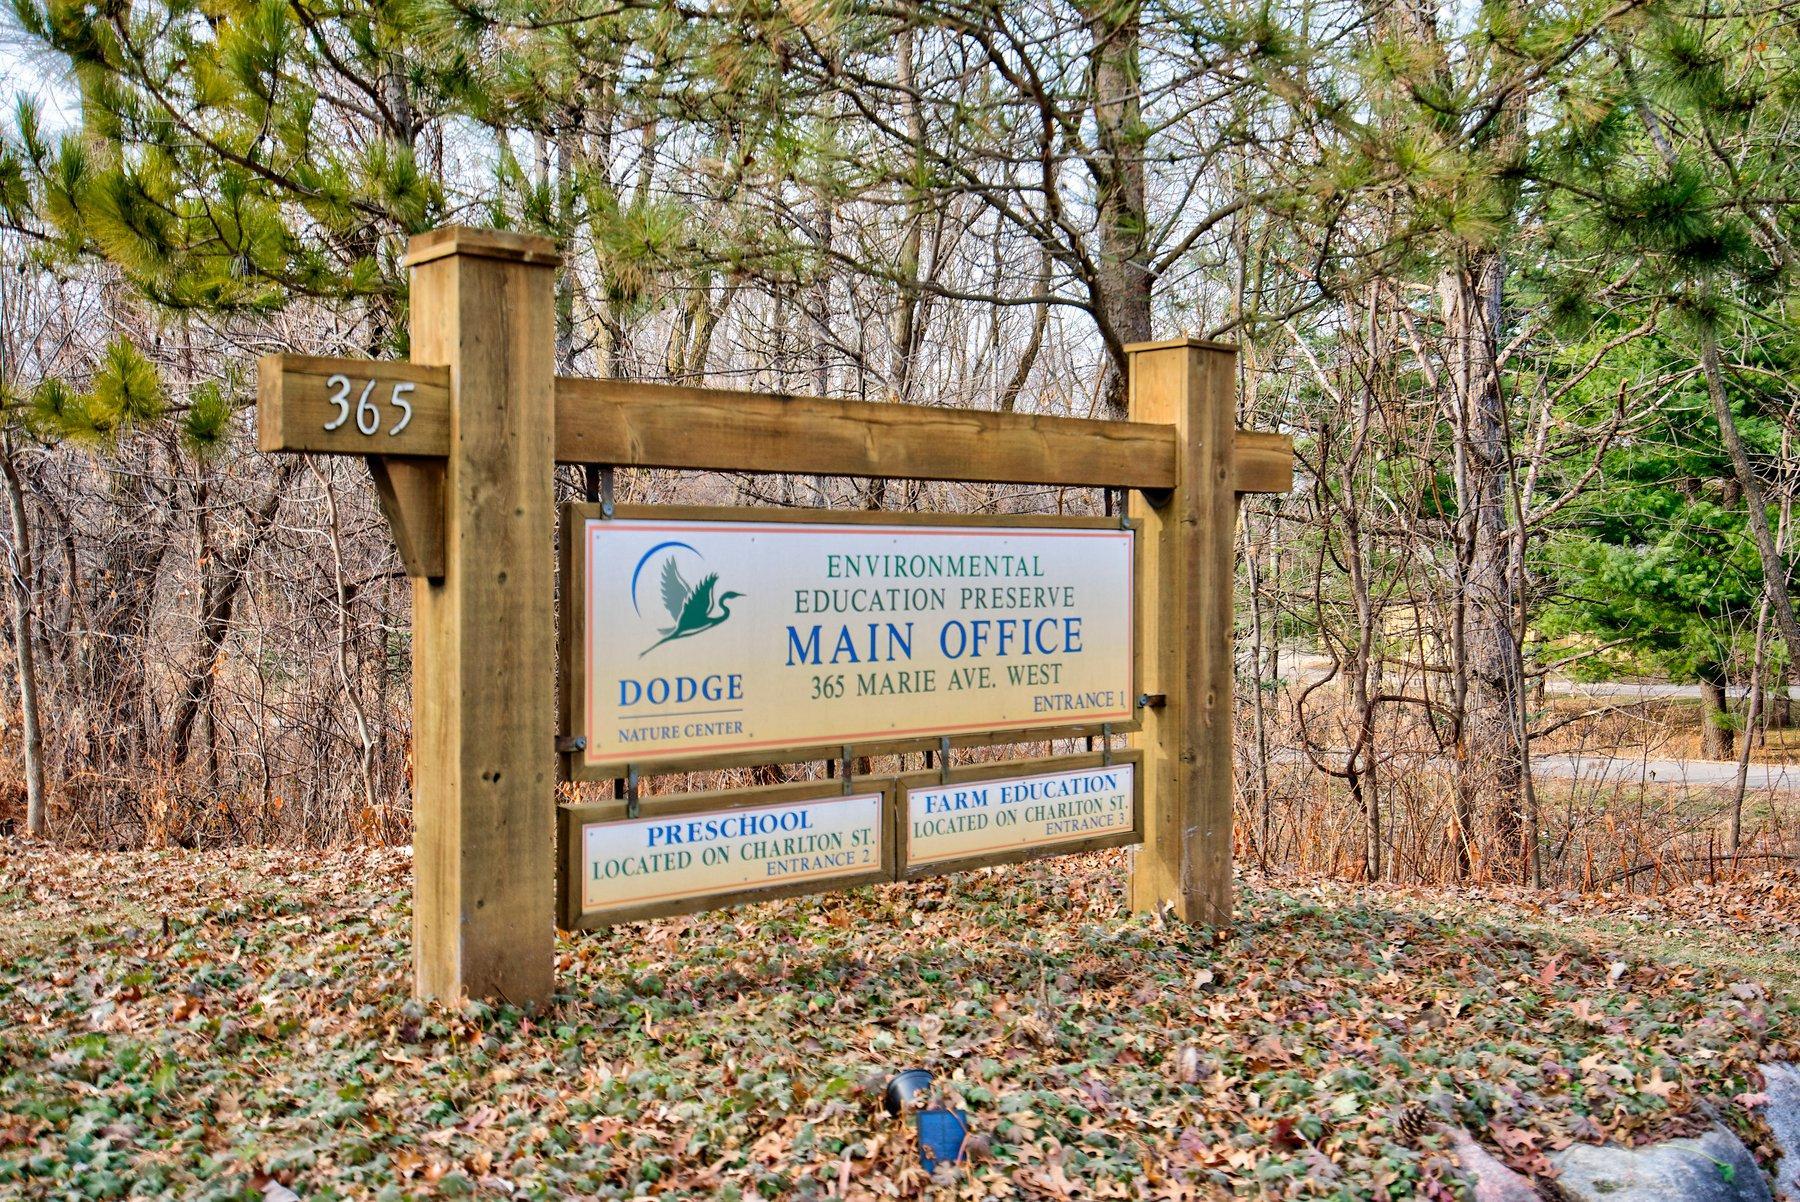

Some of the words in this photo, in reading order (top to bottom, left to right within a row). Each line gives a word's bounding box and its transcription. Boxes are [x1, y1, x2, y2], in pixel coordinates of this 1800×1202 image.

[324, 373, 415, 436] 365
[826, 554, 1045, 579] ENVIRONMENTAL
[794, 587, 946, 613] EDUCATION
[960, 586, 1076, 610] PRESERVE
[785, 622, 915, 667] MAIN
[939, 616, 1084, 660] OFFICE
[617, 673, 744, 708] DODGE
[811, 674, 845, 700] 365
[856, 670, 937, 697] MARIE
[948, 667, 997, 691] AVE.
[1007, 663, 1063, 687] WEST
[1033, 690, 1115, 713] ENTRANCE
[1119, 690, 1125, 707] 1
[617, 725, 680, 744] NATURE
[684, 720, 744, 737] CENTER
[924, 788, 990, 815] FARM
[1000, 773, 1118, 805] EDUCATION
[646, 810, 814, 849] PRESCHOOL
[913, 813, 988, 839] LOCATED
[996, 808, 1018, 827] ON
[1025, 797, 1103, 824] CHARLTON
[1110, 794, 1129, 810] ST.
[1045, 813, 1115, 836] ENTRANCE
[1118, 812, 1126, 826] 3
[591, 850, 692, 882] LOCATED
[702, 845, 730, 867] ON
[740, 831, 843, 862] CHARLTON
[850, 827, 876, 848] ST.
[766, 850, 856, 877] ENTRANCE
[862, 849, 871, 864] 2
